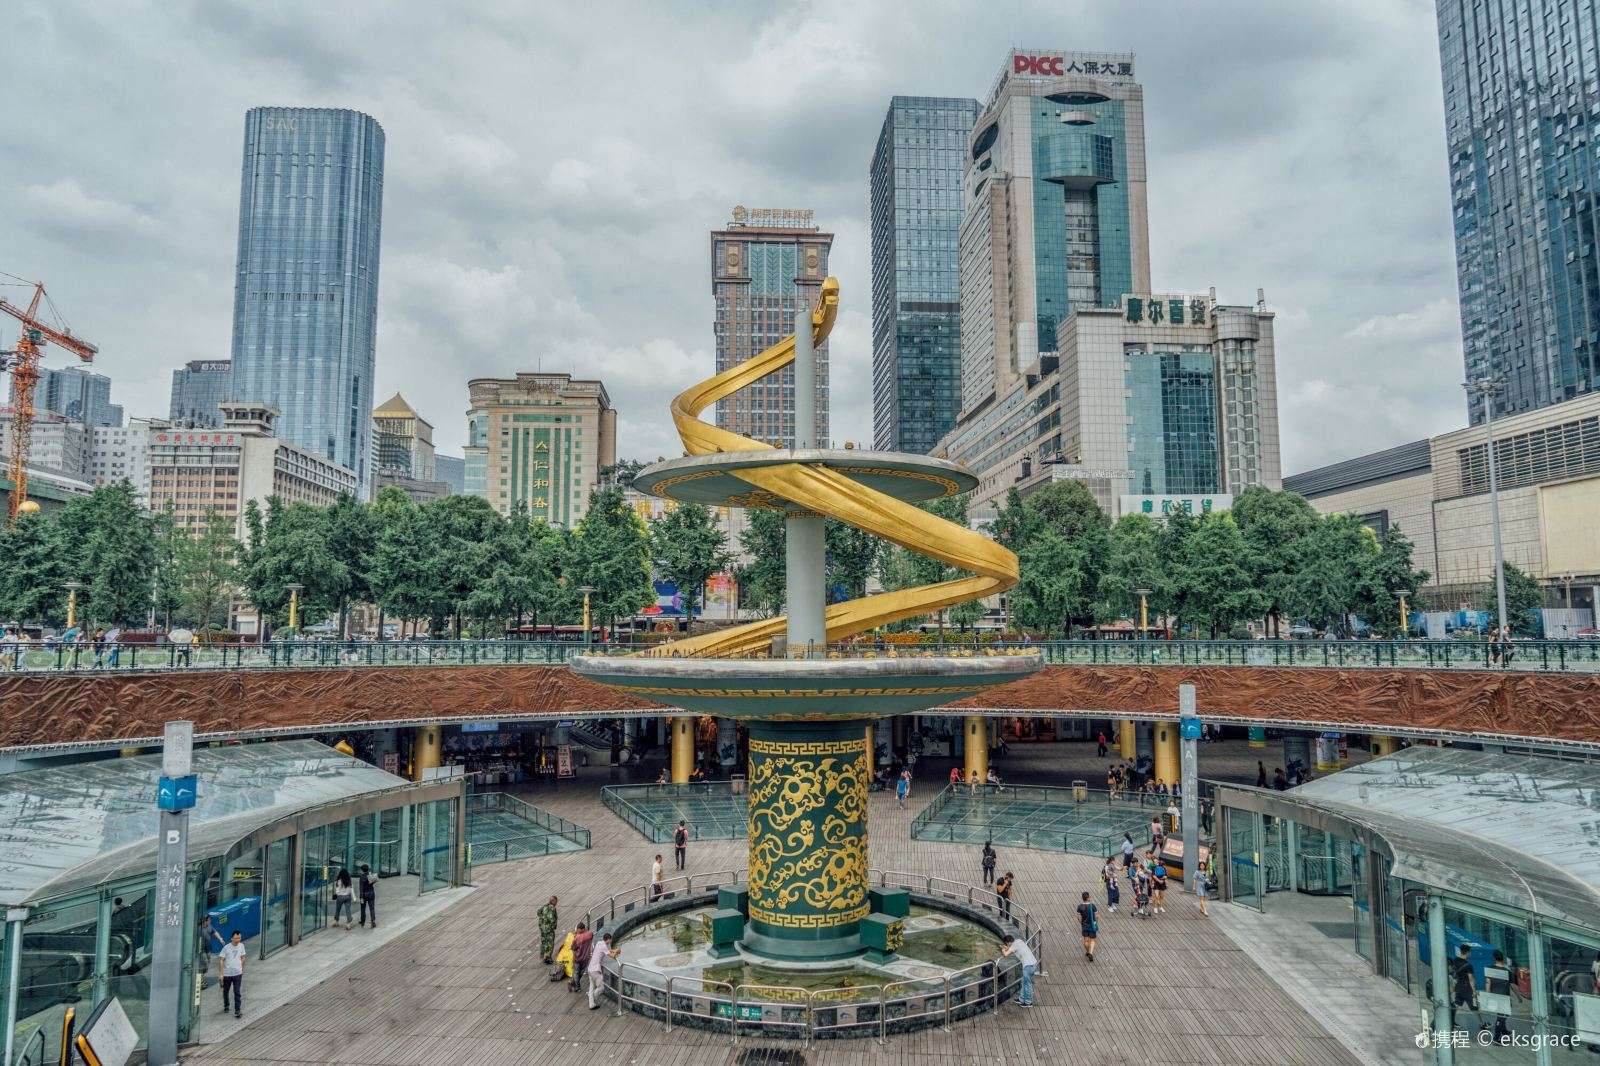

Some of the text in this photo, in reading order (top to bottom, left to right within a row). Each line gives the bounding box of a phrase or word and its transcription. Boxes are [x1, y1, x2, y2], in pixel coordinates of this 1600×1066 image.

[1013, 55, 1064, 76] PICC
[1066, 61, 1133, 77] 人保大厦
[166, 830, 180, 845] B
